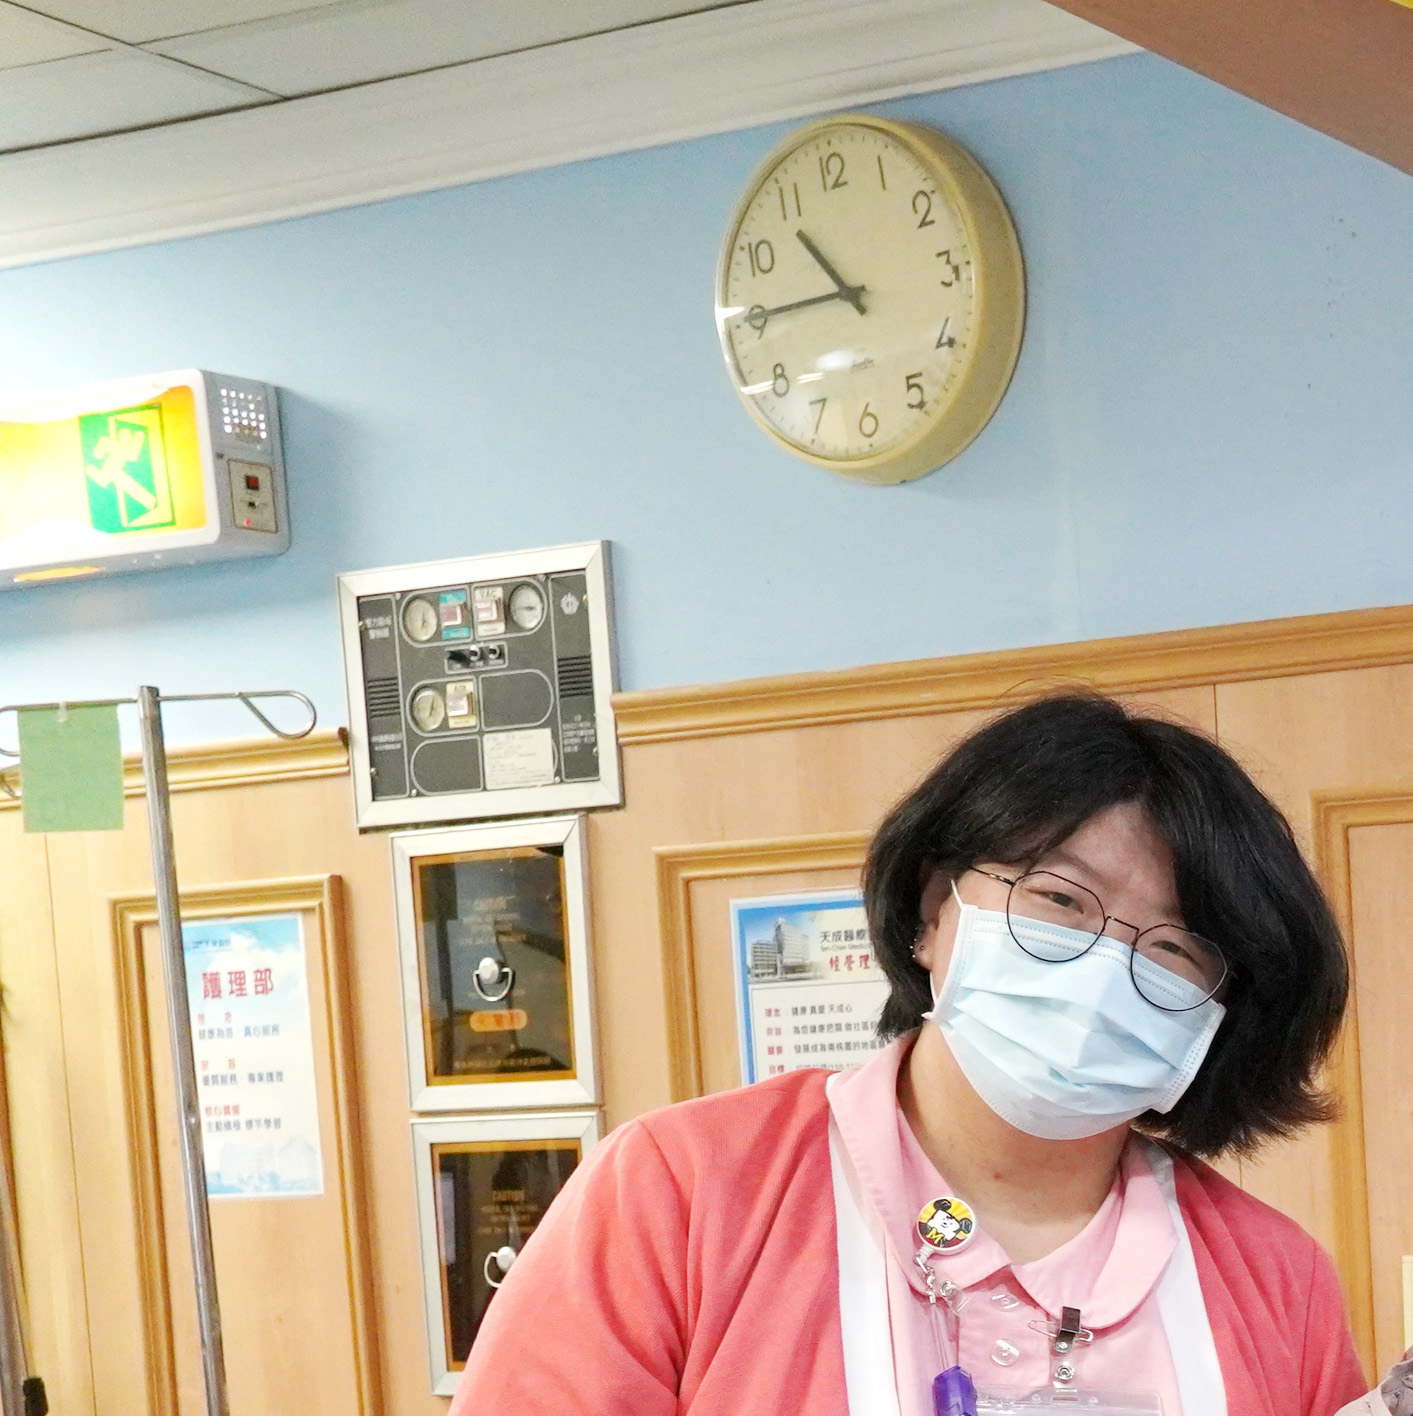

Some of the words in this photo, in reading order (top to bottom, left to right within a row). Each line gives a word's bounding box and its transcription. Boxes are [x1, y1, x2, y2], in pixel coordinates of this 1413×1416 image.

[819, 152, 848, 192] 12
[877, 154, 886, 191] 1
[777, 182, 801, 221] 11
[912, 190, 936, 229] 2
[747, 239, 775, 276] 10
[935, 249, 961, 287] 3
[935, 316, 957, 350] 4
[772, 363, 791, 398] 8
[905, 372, 927, 411] 5
[809, 397, 828, 436] 7
[858, 402, 879, 439] 6
[201, 967, 274, 1000] 護理部
